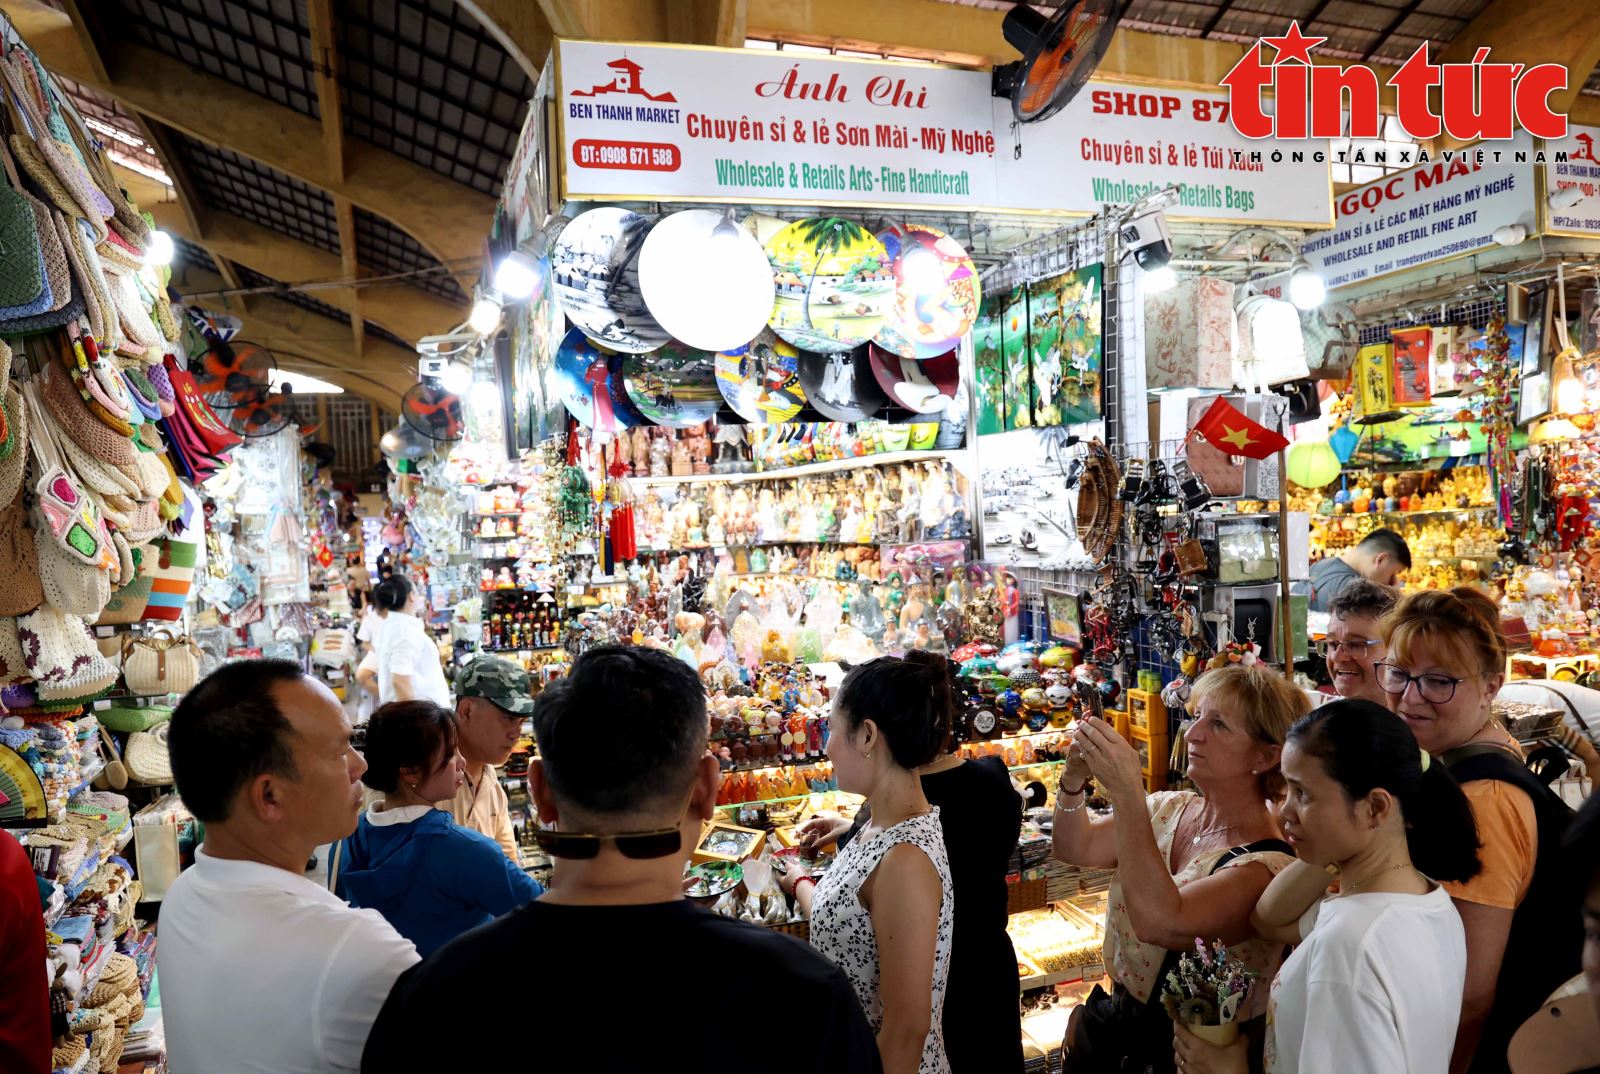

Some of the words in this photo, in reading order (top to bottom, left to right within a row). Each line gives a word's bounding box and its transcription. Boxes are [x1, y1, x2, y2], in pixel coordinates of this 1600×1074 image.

[755, 64, 850, 103] Ánh
[866, 76, 930, 109] Chi
[570, 103, 593, 119] BEN
[596, 104, 632, 121] THANH
[636, 107, 680, 124] MARKET
[1092, 90, 1181, 118] SHOP
[686, 113, 764, 142] Chuyên
[770, 116, 786, 142] sỉ
[793, 120, 806, 143] &
[813, 118, 830, 144] lẻ
[836, 122, 869, 147] Sơn
[952, 129, 995, 158] Nghệ
[629, 147, 649, 165] 671
[652, 148, 673, 166] 588
[1081, 138, 1144, 165] Chuyên
[1149, 140, 1162, 165] sỉ
[1168, 144, 1178, 166] &
[1184, 142, 1197, 167] lẻ
[1202, 146, 1223, 169] Túi
[715, 158, 785, 188] Wholesale
[789, 162, 798, 188] &
[802, 163, 846, 190] Retails
[909, 168, 970, 195] Handicraft
[1556, 163, 1568, 174] BEN
[1570, 164, 1588, 177] THANH
[1179, 183, 1222, 208] Retails
[1226, 186, 1255, 212] Bags
[1301, 237, 1332, 255] CHUYÊN
[1333, 227, 1351, 244] BÁN
[1365, 223, 1372, 234] &
[1387, 210, 1406, 227] CÁC
[1433, 193, 1462, 213] HÀNG
[1465, 184, 1481, 203] MỸ
[1485, 173, 1515, 197] NGHỆ
[1323, 242, 1374, 267] WHOLESALE
[1376, 236, 1395, 252] AND
[1398, 226, 1429, 245] RETAIL
[1432, 217, 1454, 235] FINE
[1458, 210, 1478, 227] ART
